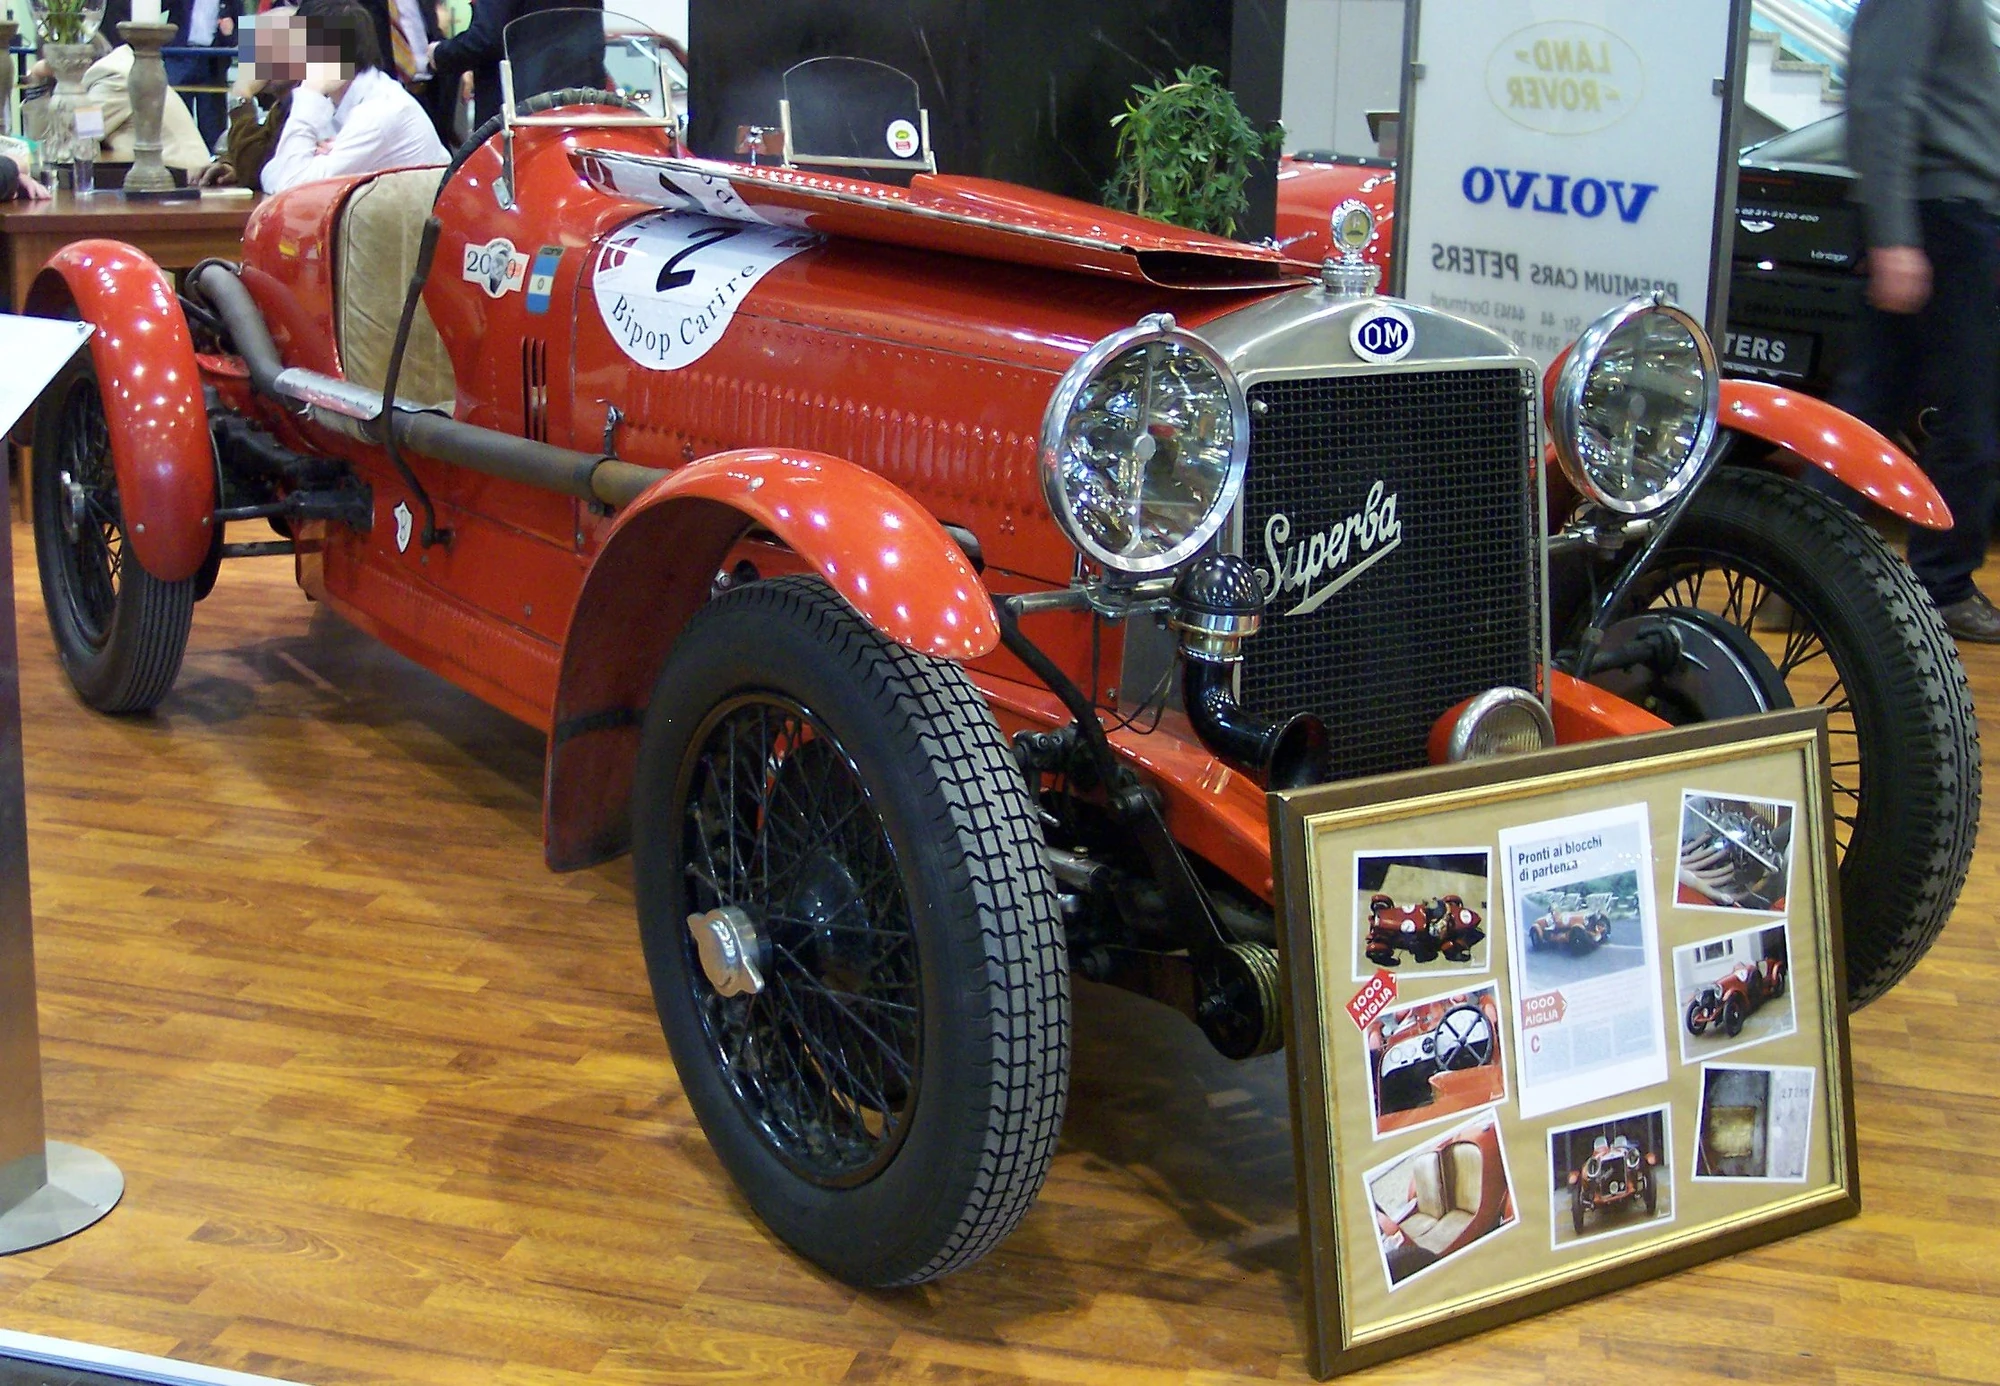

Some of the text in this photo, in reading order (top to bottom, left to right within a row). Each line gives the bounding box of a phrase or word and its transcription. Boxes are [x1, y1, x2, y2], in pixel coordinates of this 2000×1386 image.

[656, 227, 742, 293] 2
[612, 264, 758, 360] Bipop Carire
[1364, 321, 1404, 351] OM
[1253, 480, 1402, 606] Superba
[1518, 846, 1551, 866] Pronti
[1565, 834, 1603, 855] blocchi
[1519, 869, 1530, 882] di
[1353, 978, 1383, 1012] 1000
[1358, 987, 1393, 1027] MIGLIA
[1526, 996, 1556, 1011] 1000
[1525, 1008, 1559, 1026] MIGLIA
